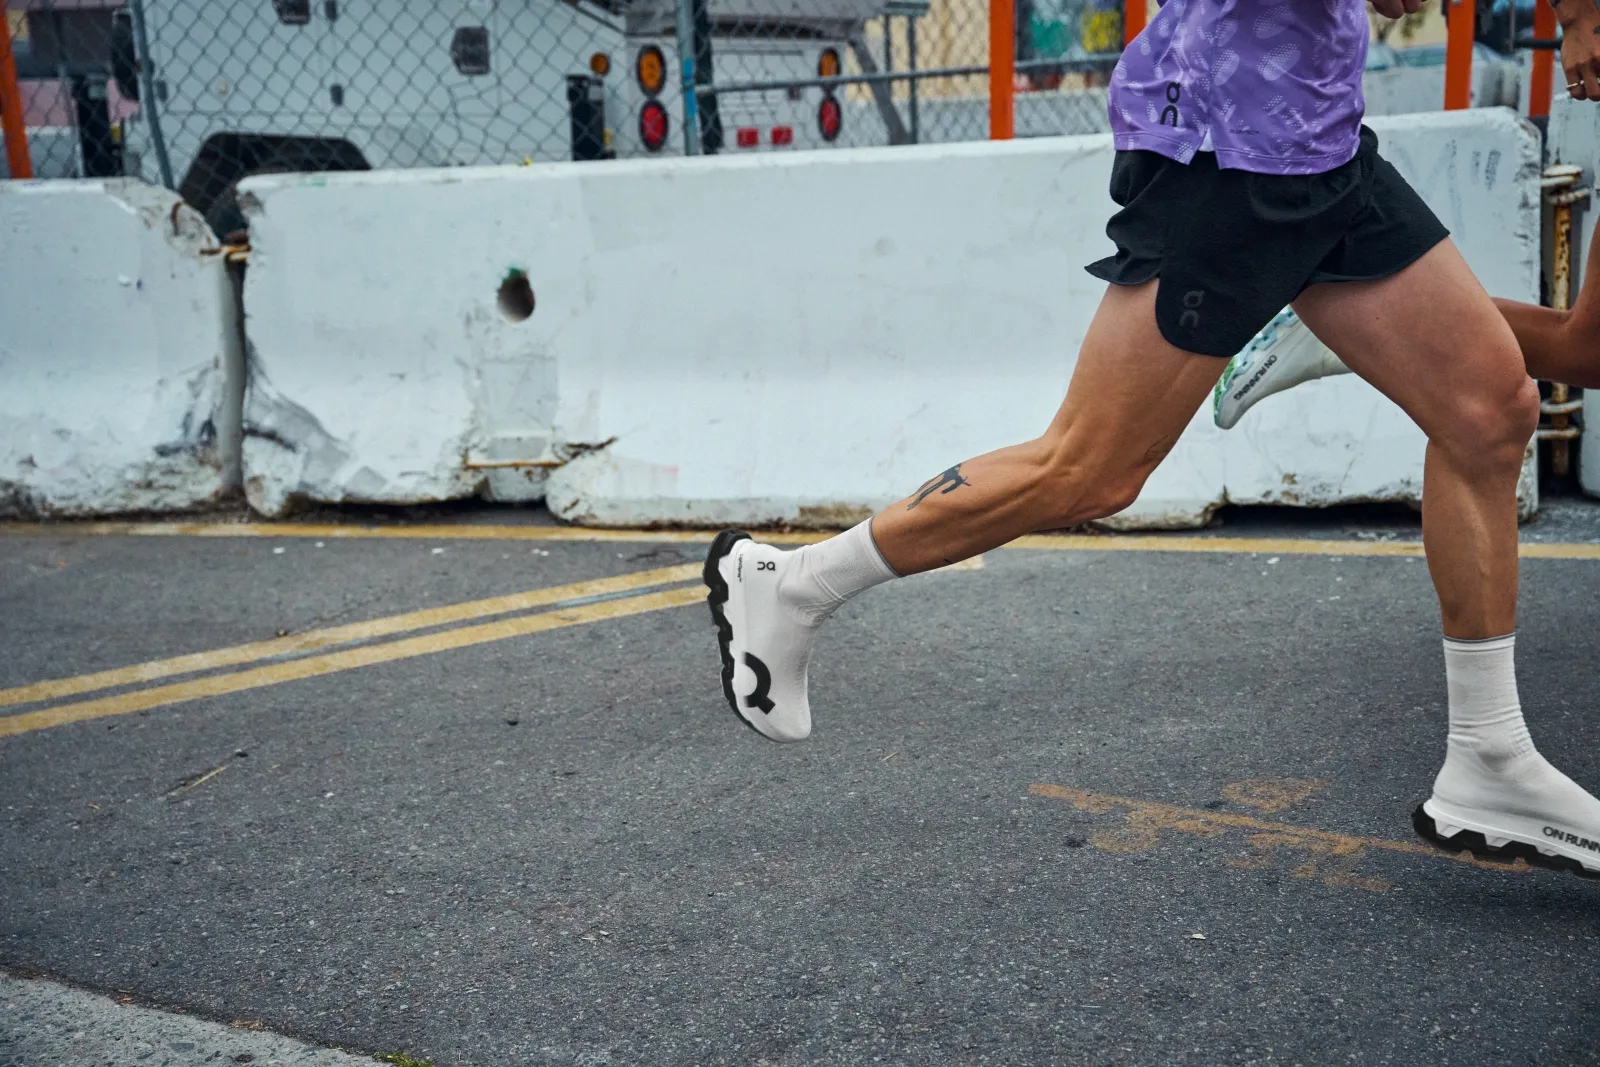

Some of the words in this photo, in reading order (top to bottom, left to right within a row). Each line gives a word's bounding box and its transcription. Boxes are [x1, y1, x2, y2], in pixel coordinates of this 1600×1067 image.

[1264, 354, 1278, 369] ON
[1233, 366, 1267, 400] RUNNING
[1543, 826, 1565, 841] ON
